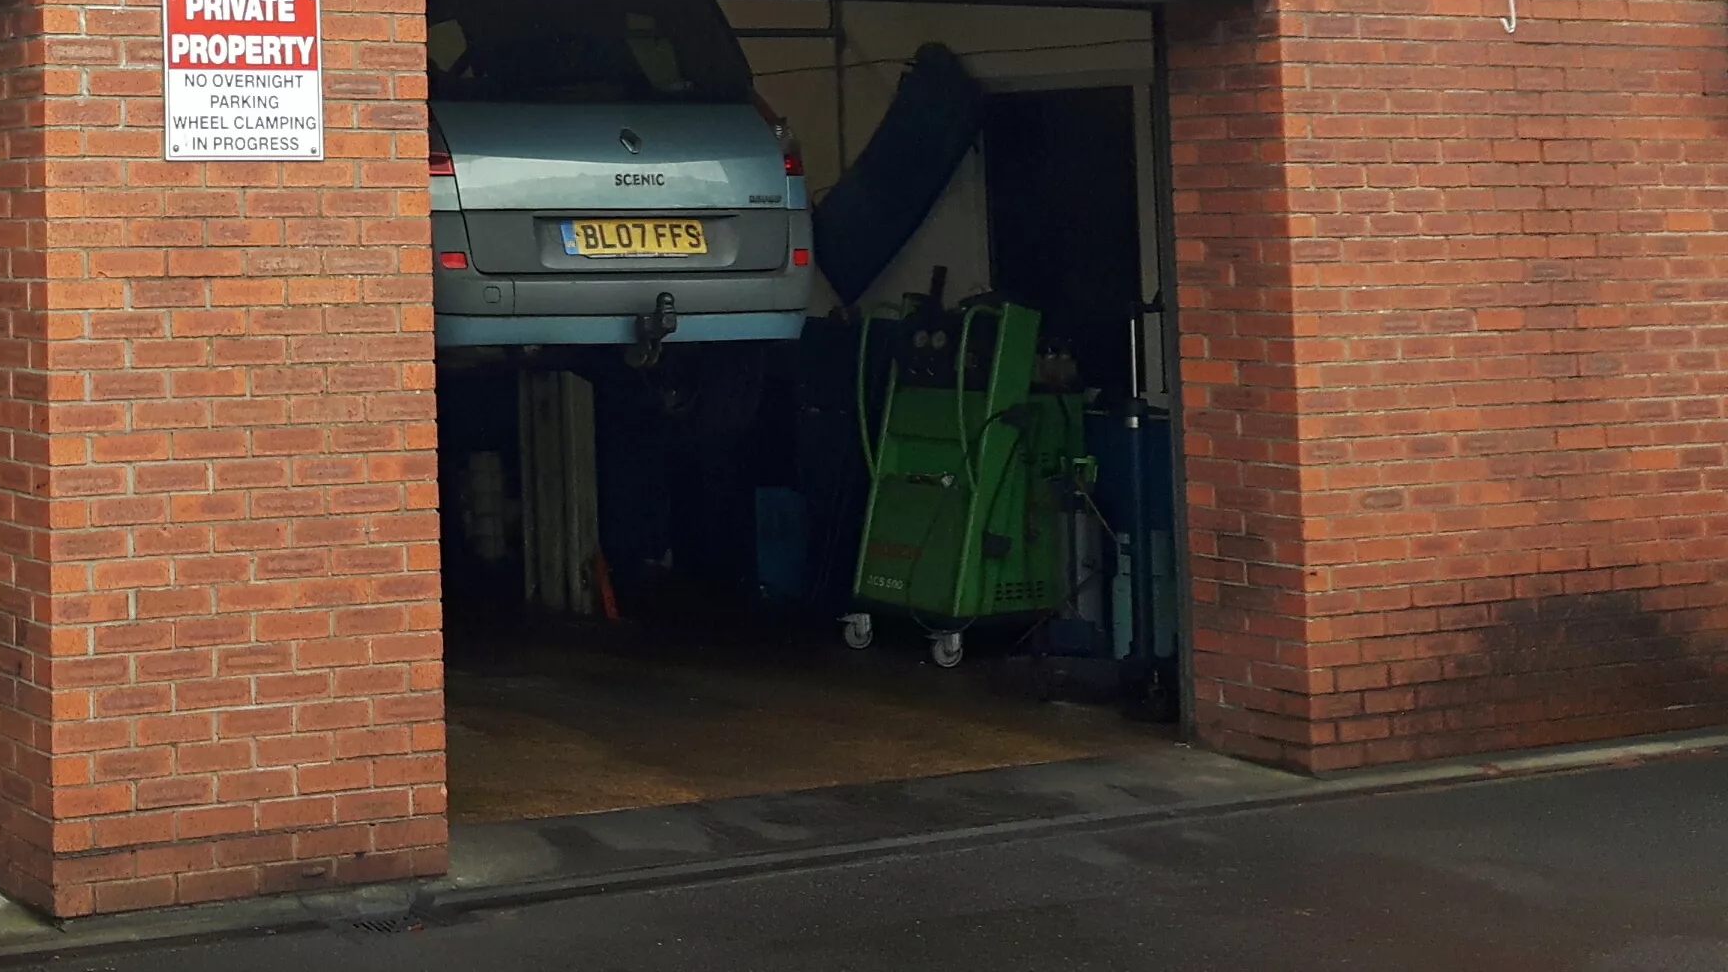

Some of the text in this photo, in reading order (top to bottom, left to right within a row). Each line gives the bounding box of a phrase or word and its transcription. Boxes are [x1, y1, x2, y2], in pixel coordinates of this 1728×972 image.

[171, 34, 314, 65] PROPERTY
[184, 74, 304, 88] NO OVERNIGHT
[210, 95, 279, 109] PARKING
[173, 116, 317, 130] WHEEL CLAMPING
[192, 137, 299, 151] IN PROGRESS
[614, 173, 665, 187] SCENIC
[581, 224, 702, 249] BL07 FFS
